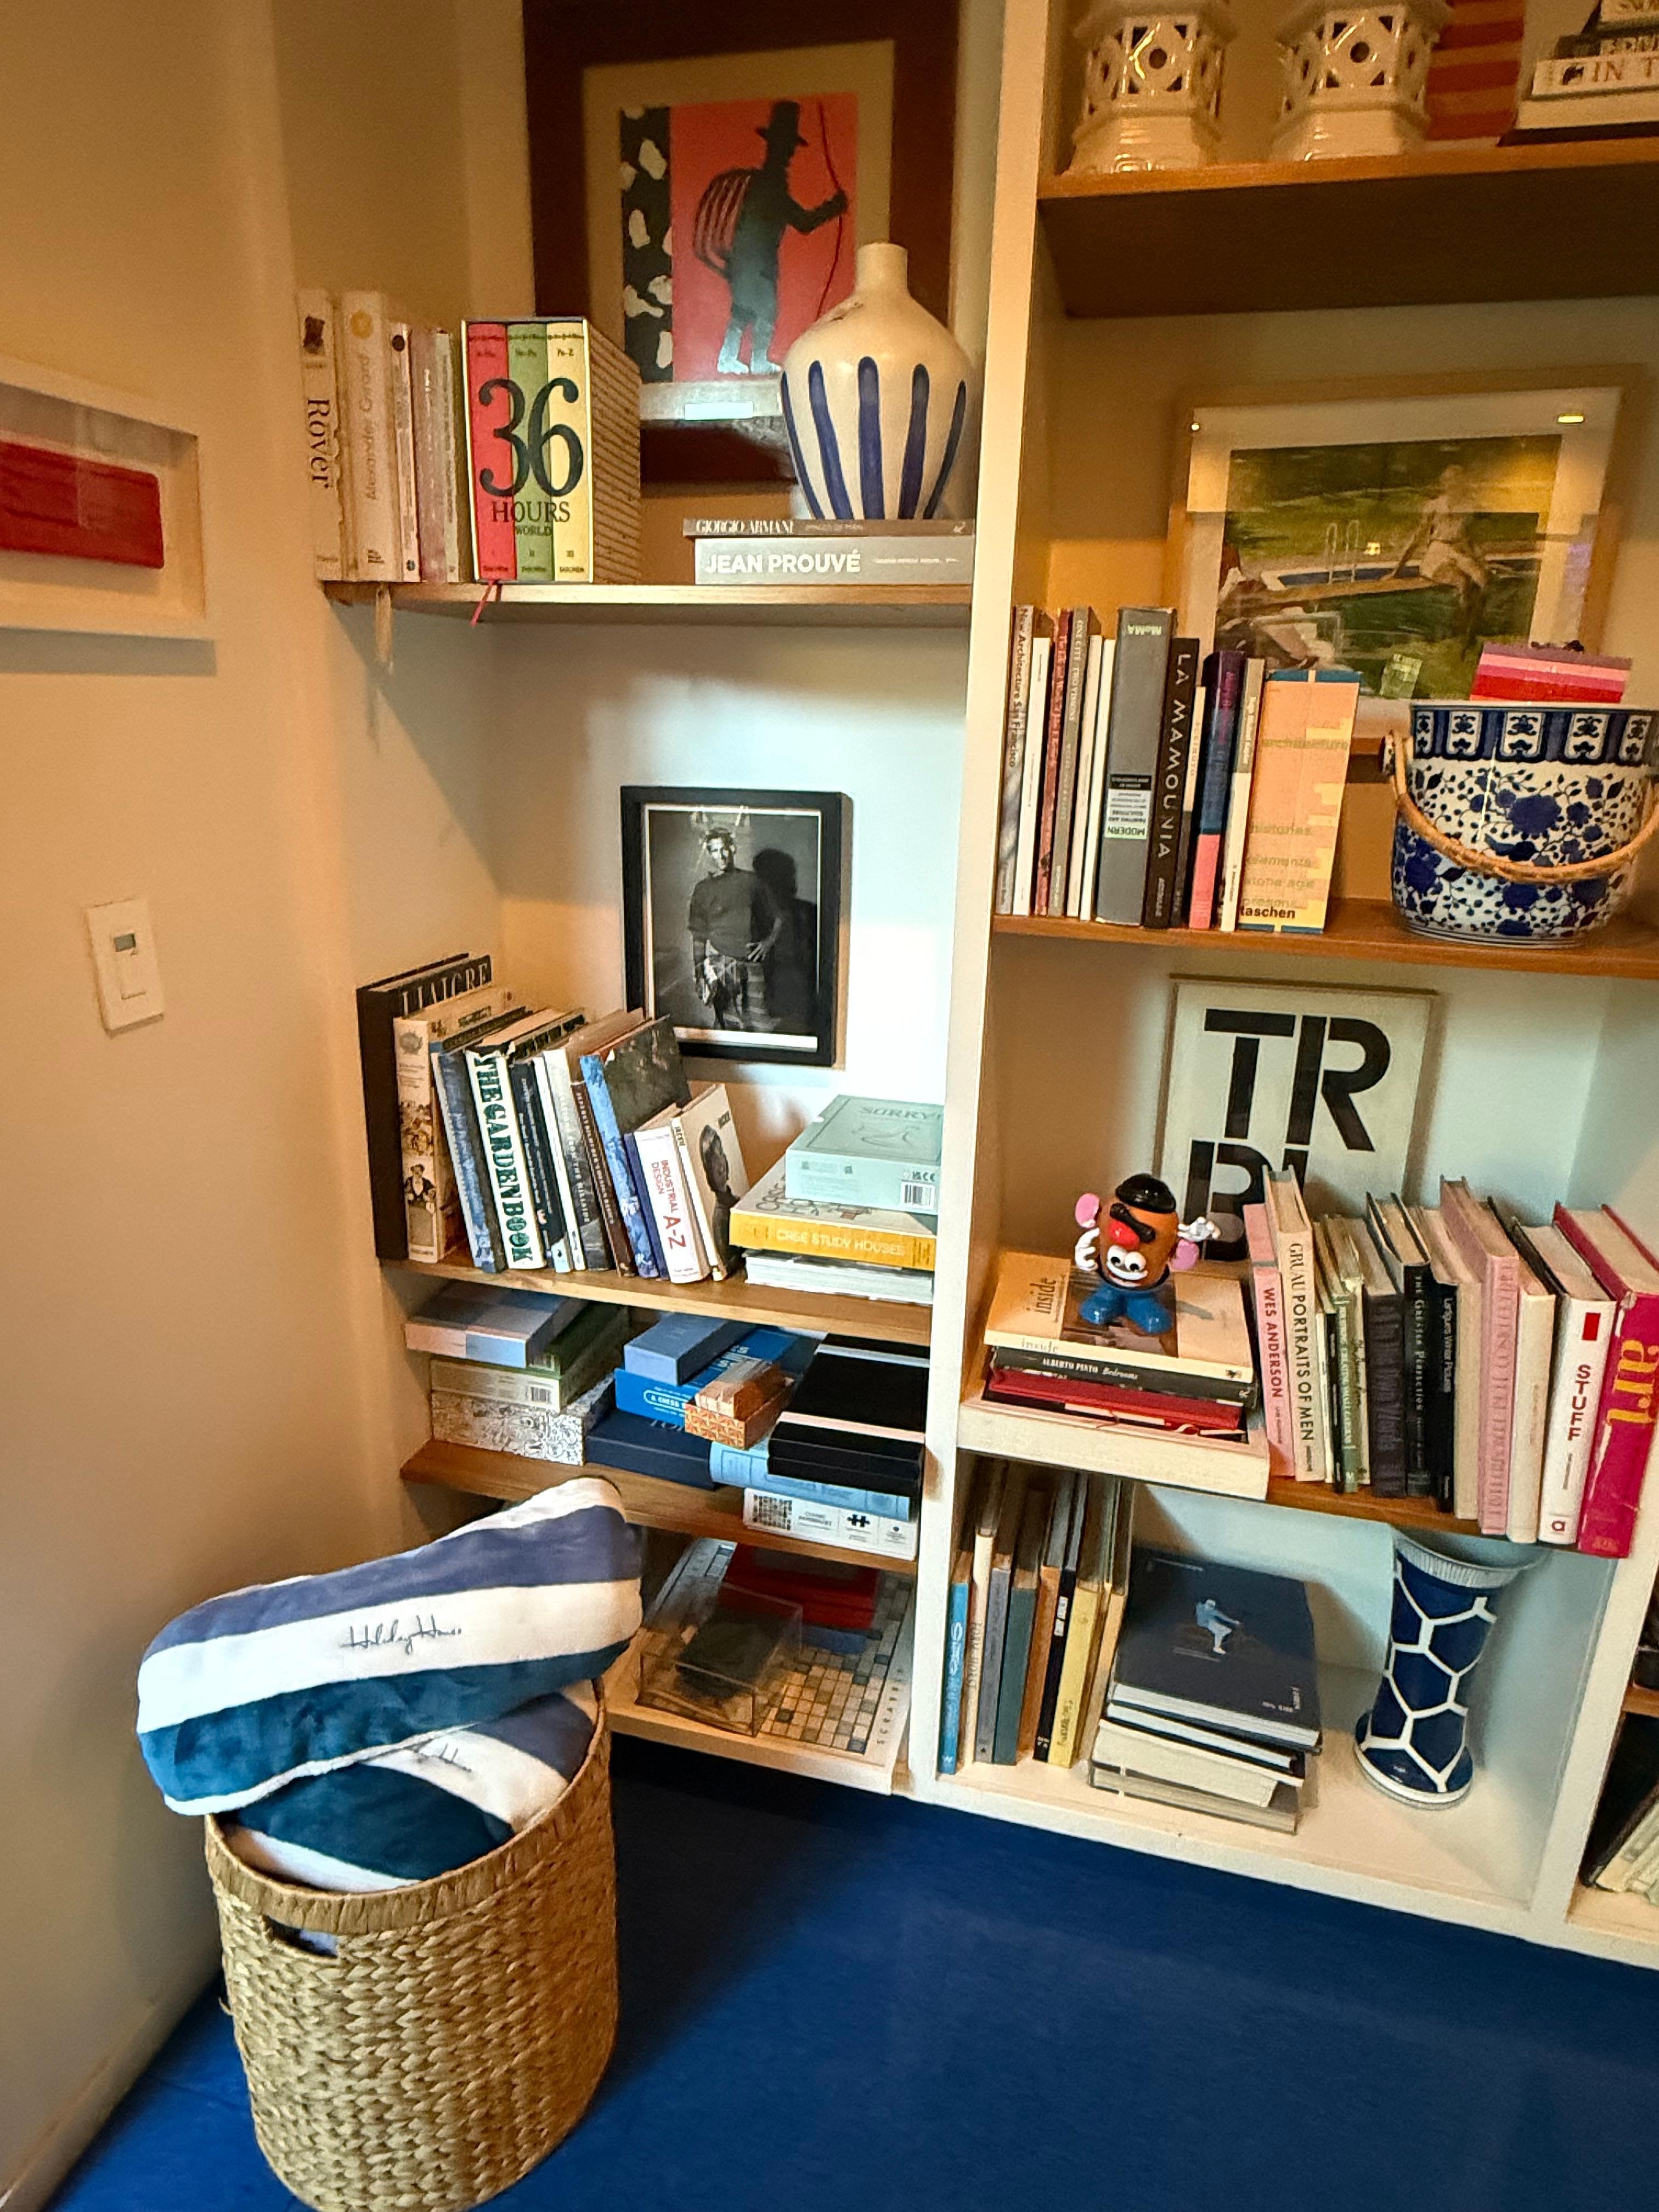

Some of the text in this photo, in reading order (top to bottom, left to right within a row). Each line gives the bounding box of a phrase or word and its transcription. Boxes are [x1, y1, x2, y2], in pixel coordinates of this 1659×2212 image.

[307, 399, 332, 489] Rover
[478, 377, 584, 497] 36
[492, 501, 571, 523] HOURS
[696, 520, 746, 534] GIORGIO
[749, 520, 794, 534] ARMANI
[515, 526, 552, 537] WORLD
[704, 549, 861, 574] JEAN PROUVÉ
[1127, 625, 1163, 635] MoMA
[1014, 635, 1027, 699] Architecture
[1157, 654, 1192, 859] LA MAMOUNIA
[1106, 827, 1146, 836] MODERN
[1240, 905, 1296, 919] taschen
[473, 1049, 500, 1103] THE
[1204, 1008, 1391, 1152] TR
[483, 1103, 521, 1199] GARDEN
[651, 1161, 664, 1195] DESIGN
[660, 1159, 679, 1215] INDUSTRIAL
[502, 1199, 533, 1262] BOOK
[663, 1215, 686, 1250] A-Z
[776, 1229, 907, 1256] CASE STUDY HOUSES
[1289, 1242, 1306, 1292] GRUAU
[1026, 1277, 1057, 1315] inside
[1263, 1287, 1278, 1317] WES
[1292, 1295, 1311, 1377] PORTRAITS
[1042, 1358, 1138, 1381] ALBERTO PINTO Bedrooms
[1266, 1322, 1283, 1398] ANDERSON
[1297, 1381, 1313, 1402] OF
[1605, 1339, 1659, 1426] art
[1566, 1364, 1593, 1442] STUFF
[1298, 1406, 1314, 1441] MEN
